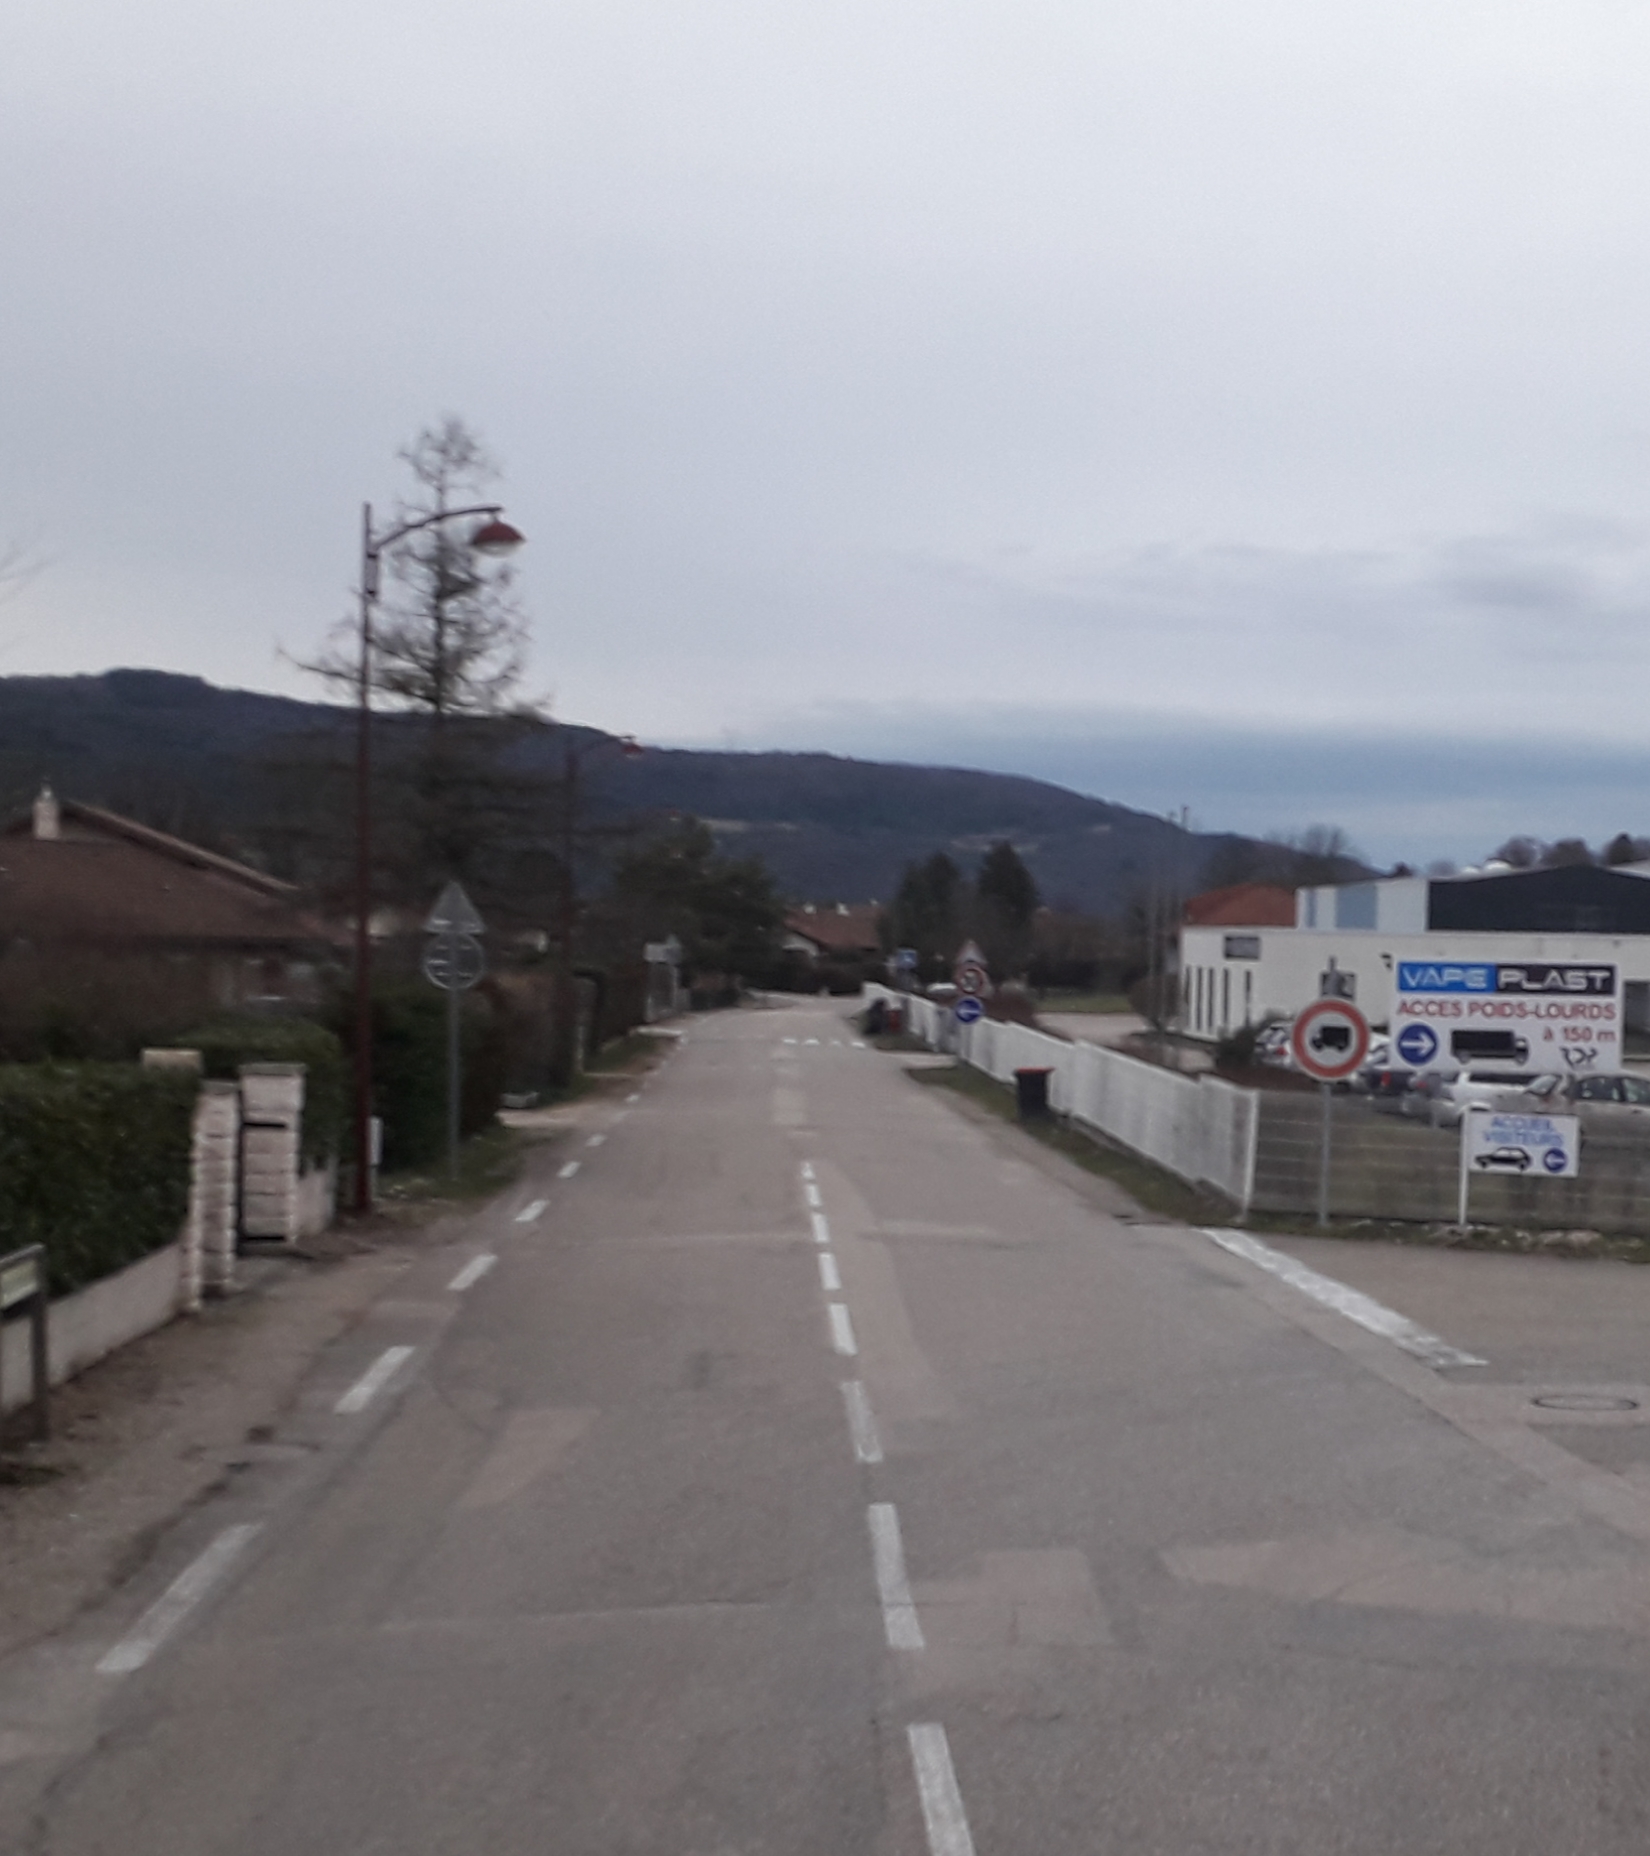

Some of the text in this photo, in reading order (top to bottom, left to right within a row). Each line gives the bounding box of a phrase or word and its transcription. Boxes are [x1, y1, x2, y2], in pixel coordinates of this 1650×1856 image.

[1402, 968, 1611, 990] VAPE PLAST
[1468, 1002, 1616, 1020] POIDS-LOURDS
[1563, 1027, 1592, 1042] 150
[1597, 1030, 1616, 1042] m
[1491, 1117, 1555, 1131] ACCUEIL
[1482, 1130, 1565, 1146] VISITEURS
